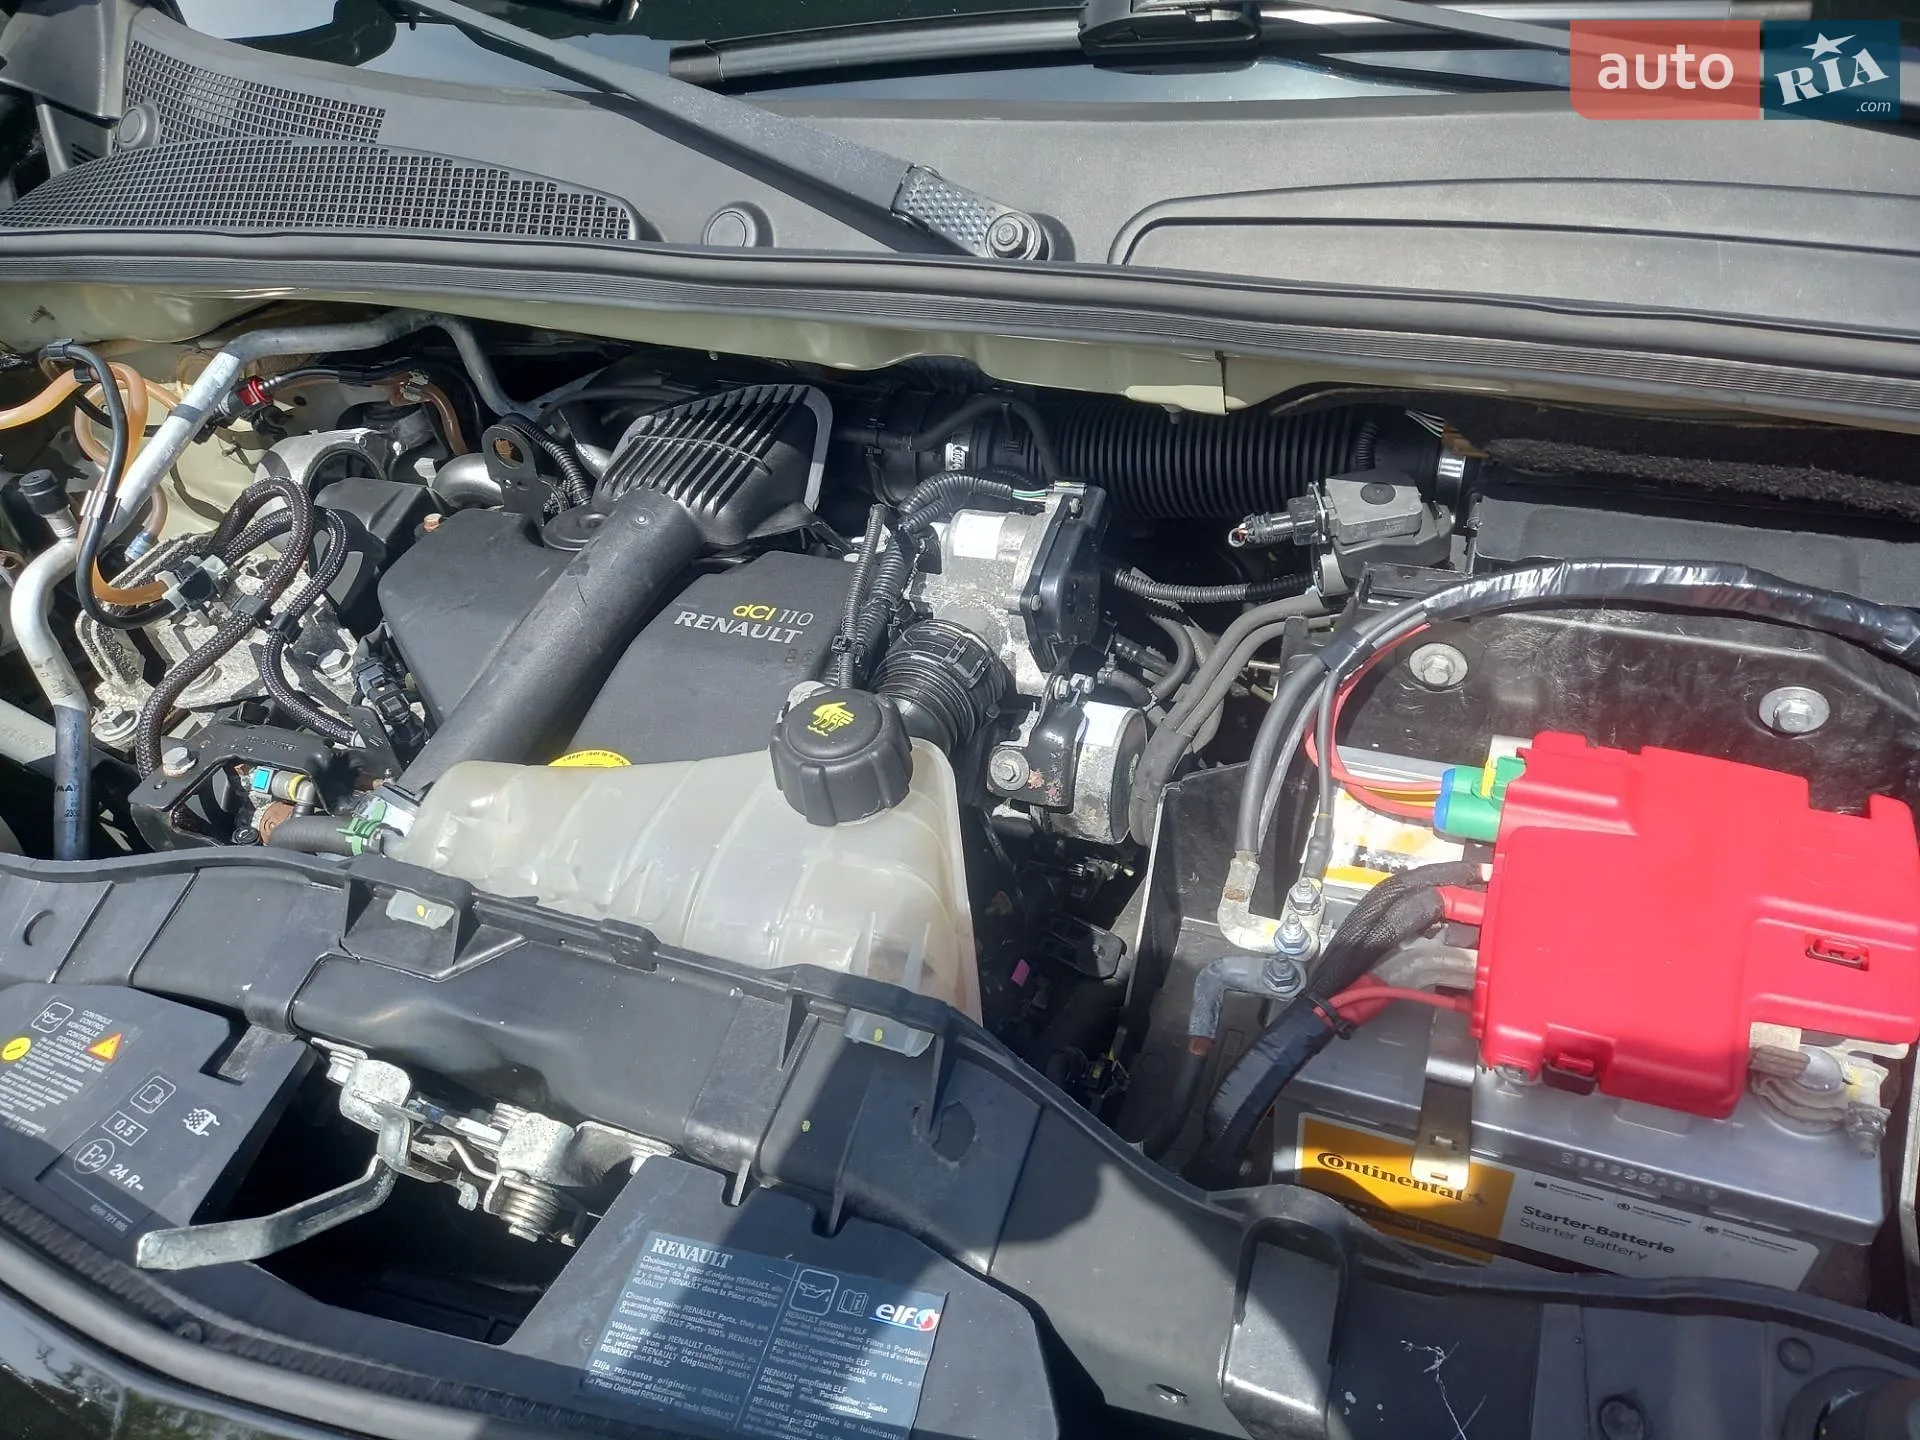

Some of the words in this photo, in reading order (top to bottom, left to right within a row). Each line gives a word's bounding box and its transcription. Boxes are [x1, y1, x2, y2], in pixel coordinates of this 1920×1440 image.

[777, 608, 814, 626] 110
[674, 610, 804, 645] RENAULT
[114, 1119, 137, 1137] 0,5
[78, 1143, 108, 1169] E2
[108, 1163, 130, 1181] 24
[1317, 1152, 1463, 1201] Continental
[1523, 1205, 1676, 1255] Starter-Batterie
[1519, 1217, 1578, 1242] Starter
[1583, 1235, 1648, 1262] Battery
[651, 1238, 732, 1267] RENAULT
[668, 1277, 700, 1289] RENAULT
[683, 1305, 716, 1317] RENAULT
[875, 1303, 918, 1325] elf
[639, 1328, 651, 1336] Sie
[667, 1335, 703, 1349] RENAULT
[650, 1313, 683, 1326] RENAULT
[727, 1333, 763, 1346] RENAULT
[600, 1344, 633, 1357] RENAULT
[641, 1346, 678, 1360] RENAULT
[645, 1339, 660, 1347] von
[664, 1343, 677, 1351] der
[822, 1359, 840, 1368] with
[856, 1358, 871, 1367] ELF
[613, 1366, 653, 1381] repuestos
[763, 1367, 797, 1380] RENAULT
[833, 1385, 847, 1394] ELF
[640, 1390, 674, 1404] RENAULT
[751, 1396, 790, 1411] RENAULT
[803, 1419, 817, 1428] ELF
